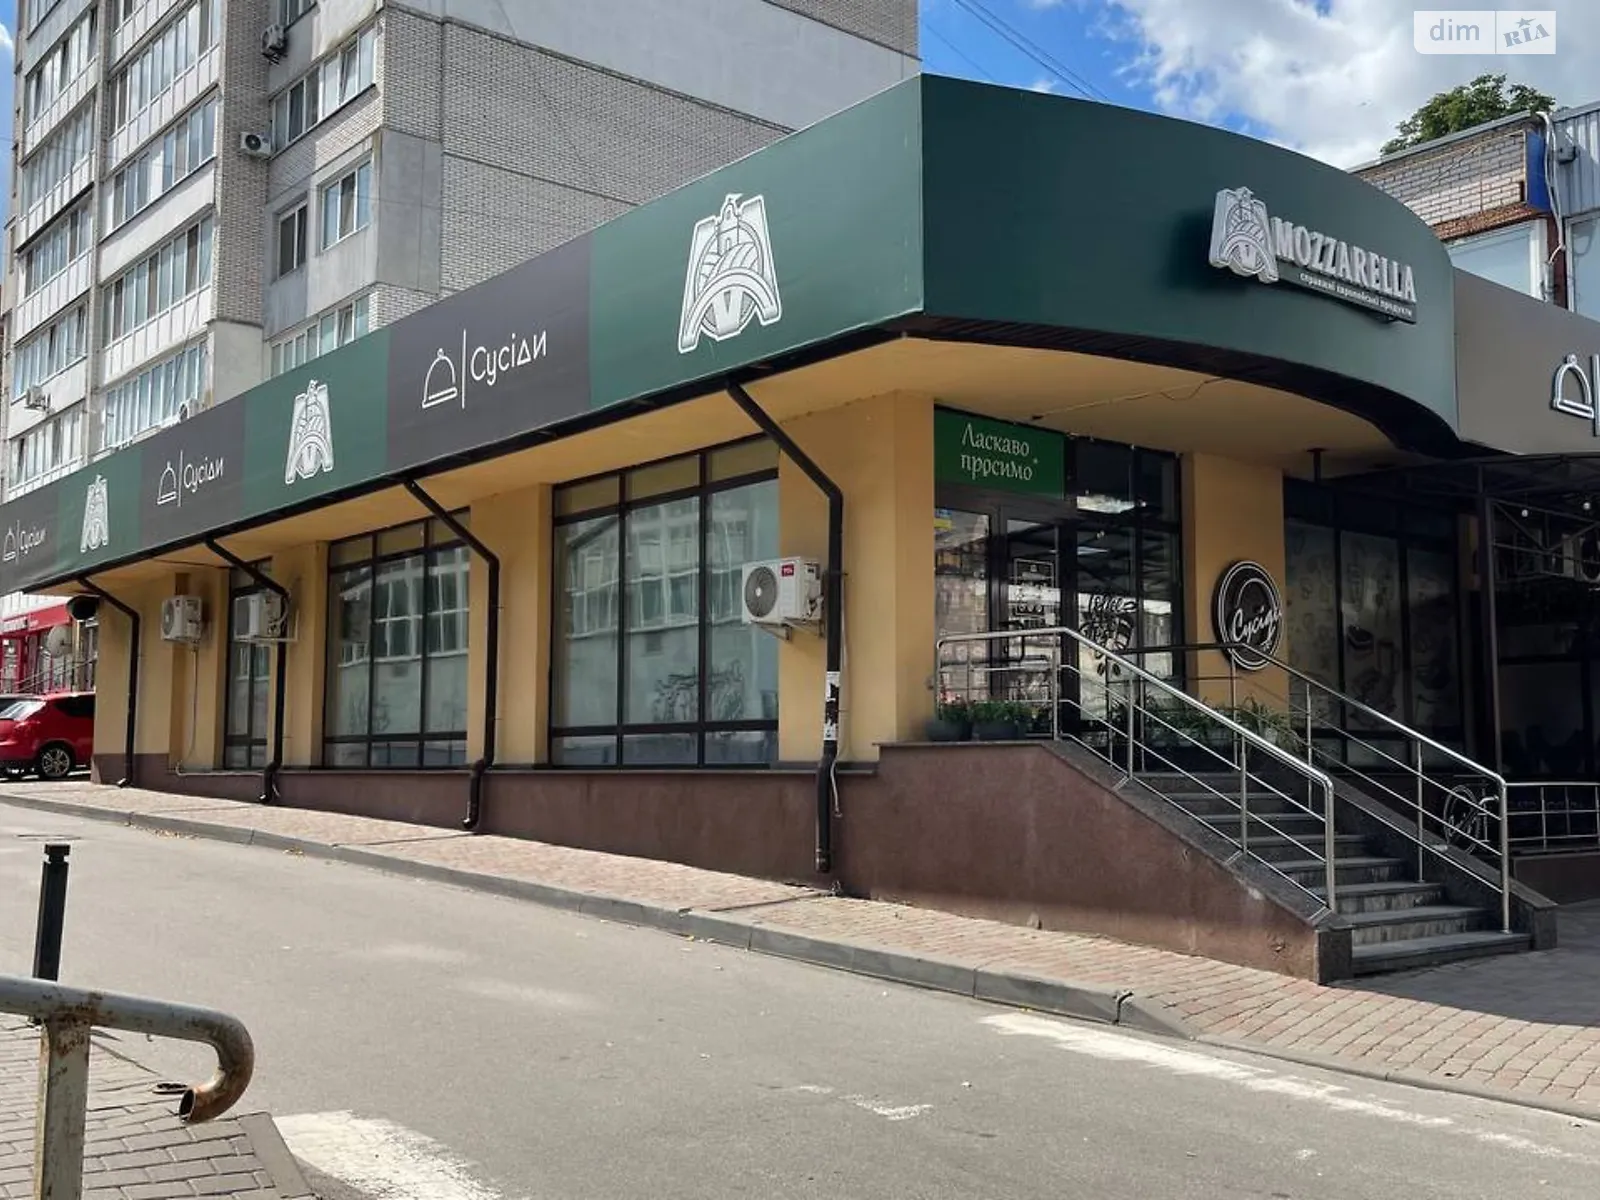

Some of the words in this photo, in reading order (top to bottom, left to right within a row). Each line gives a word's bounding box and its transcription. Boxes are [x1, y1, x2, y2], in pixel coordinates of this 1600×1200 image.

[1271, 216, 1417, 303] MOZZARELLA
[470, 329, 547, 386] Сусіди
[961, 422, 1030, 457] Ласкаво
[183, 456, 225, 493] Сусіди
[961, 454, 1034, 481] просимо
